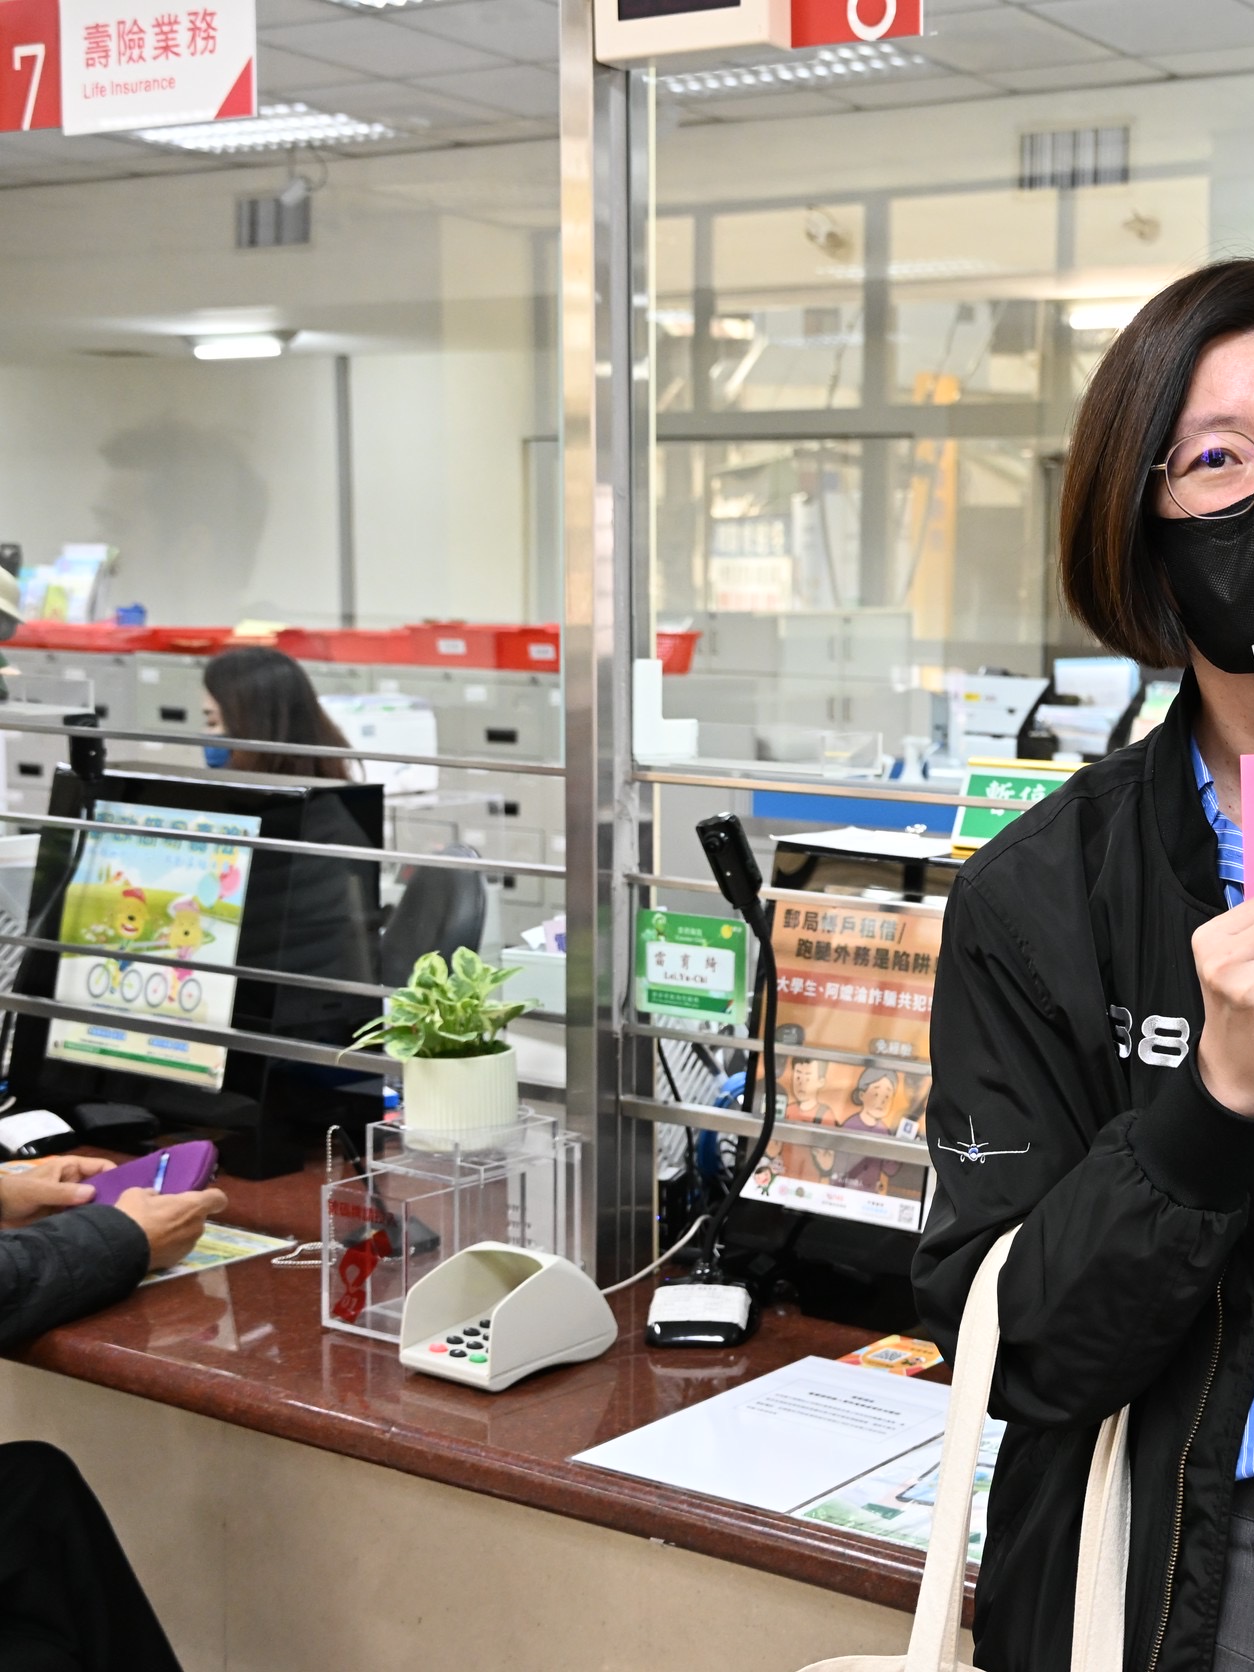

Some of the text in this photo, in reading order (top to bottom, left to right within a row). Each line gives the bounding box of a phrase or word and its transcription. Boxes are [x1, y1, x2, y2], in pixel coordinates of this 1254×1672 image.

[83, 8, 218, 69] 壽險業務
[13, 44, 46, 131] 7
[83, 75, 176, 99] Life Insurance
